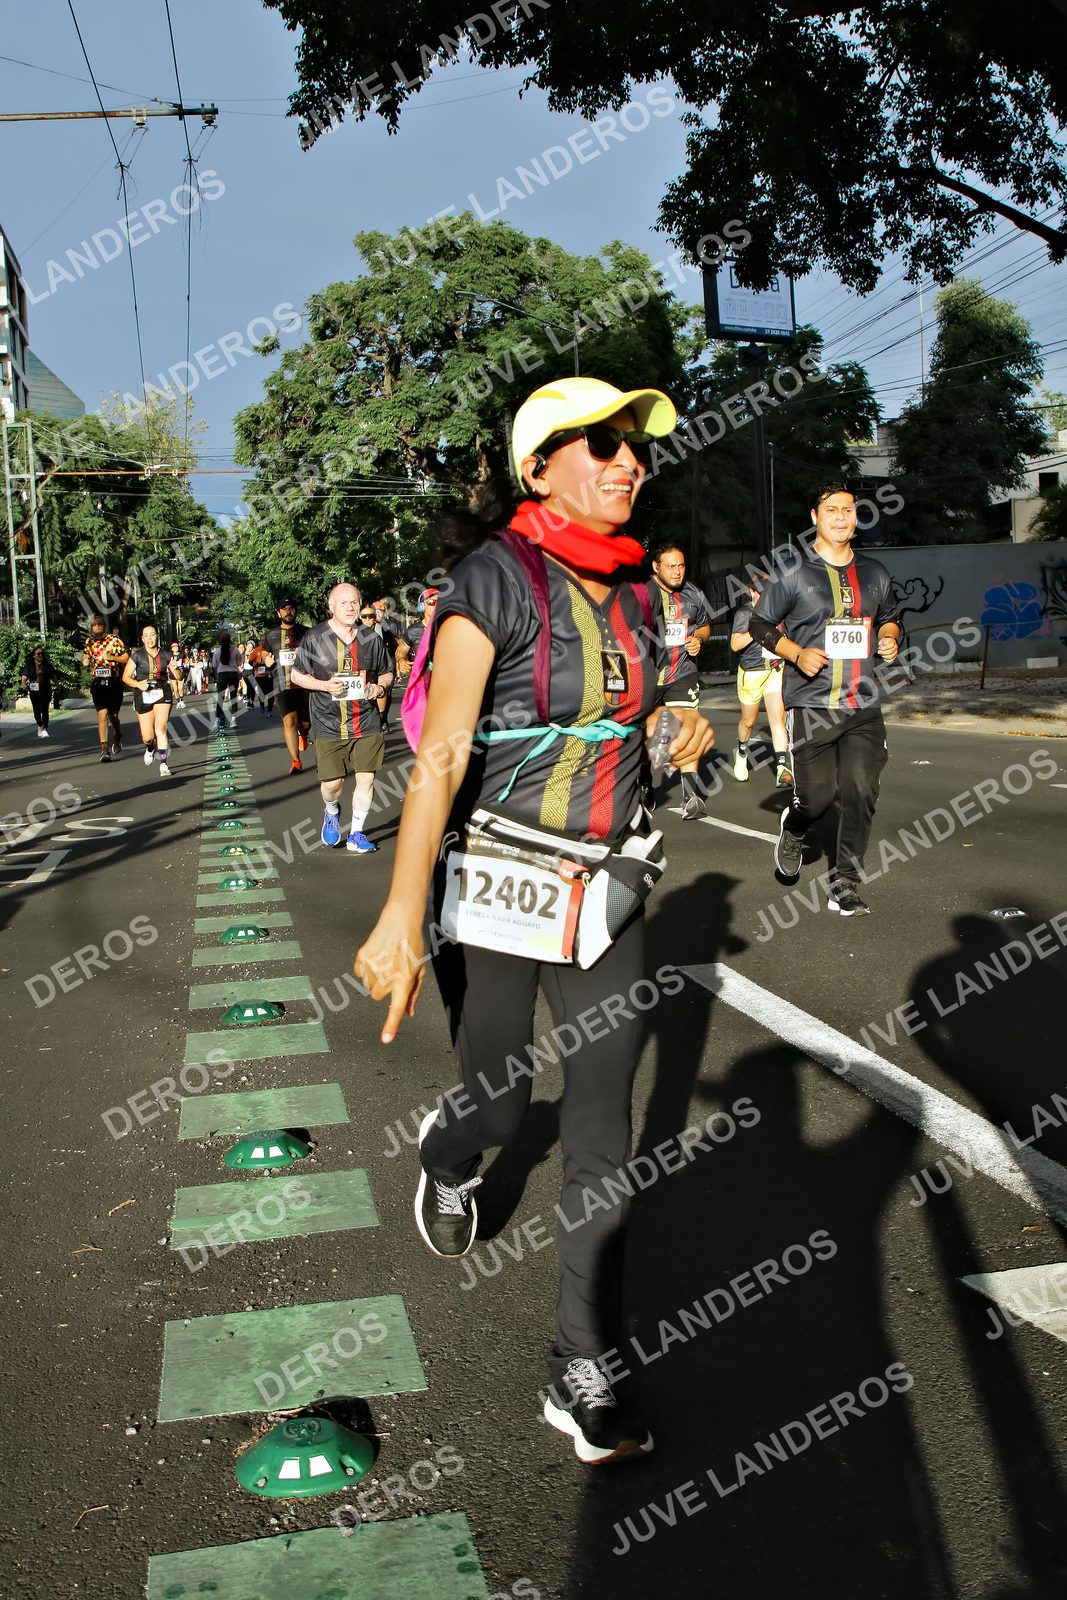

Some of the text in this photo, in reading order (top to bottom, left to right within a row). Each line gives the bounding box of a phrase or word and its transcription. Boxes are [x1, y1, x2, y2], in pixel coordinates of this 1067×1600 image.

[832, 631, 862, 644] 8760
[453, 867, 560, 920] 12402
[465, 908, 541, 930] TERESA NAVA AGUAYO
